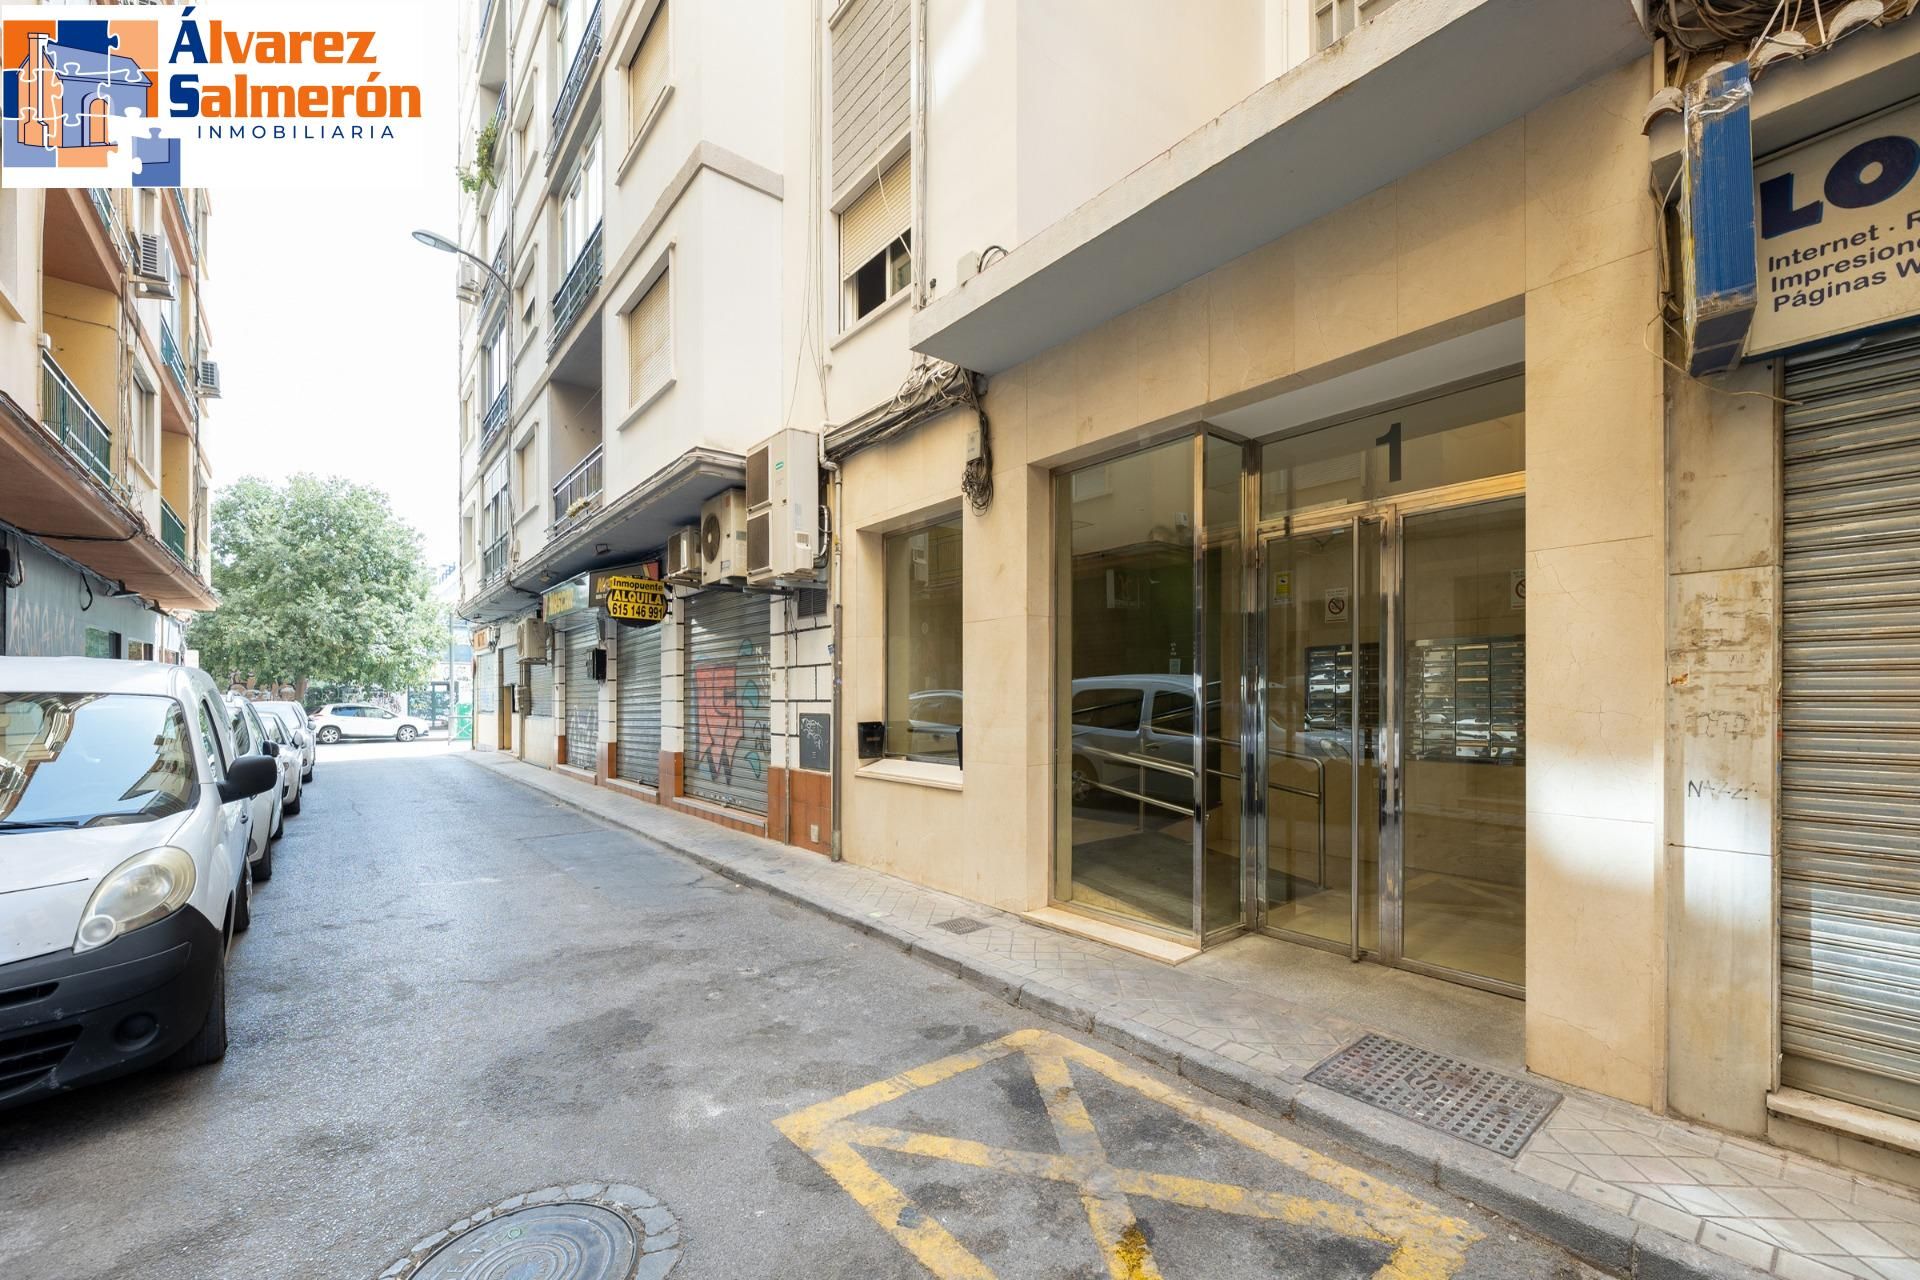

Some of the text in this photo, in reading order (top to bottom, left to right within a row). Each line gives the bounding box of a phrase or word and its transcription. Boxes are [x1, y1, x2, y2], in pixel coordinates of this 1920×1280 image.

[1769, 224, 1879, 272] Internet
[1771, 239, 1920, 292] Impresion
[1774, 271, 1886, 313] Páginas
[1375, 422, 1401, 482] 1
[613, 578, 663, 590] Inmopuente
[613, 590, 662, 605] ALQUILA
[612, 603, 663, 619] 615 146 991
